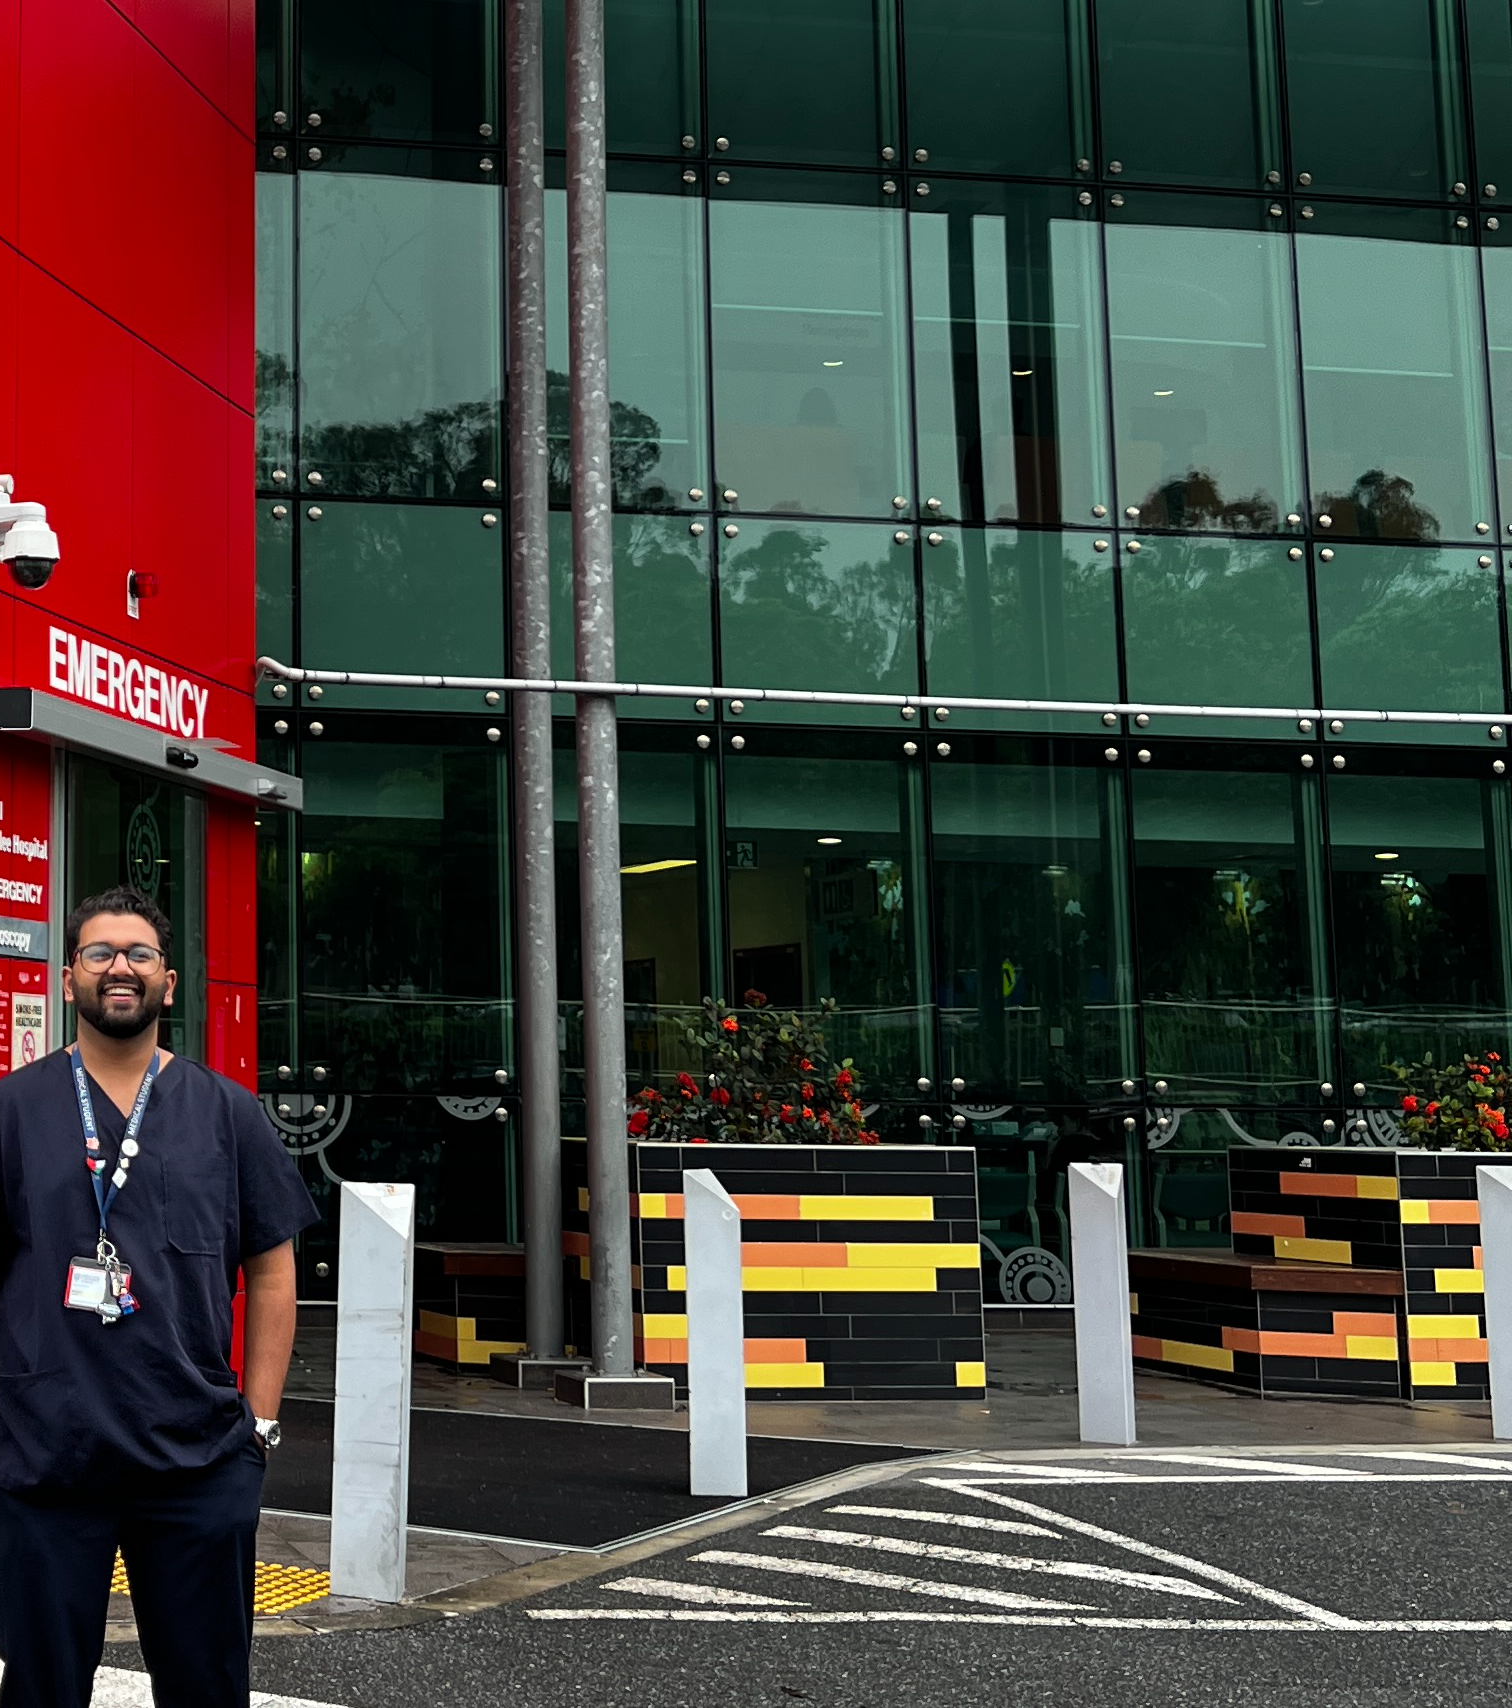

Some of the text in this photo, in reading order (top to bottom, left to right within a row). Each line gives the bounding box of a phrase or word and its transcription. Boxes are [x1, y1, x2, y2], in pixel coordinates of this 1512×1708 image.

[49, 625, 209, 739] EMERGENCY
[13, 833, 48, 862] Hospital
[75, 1066, 95, 1132] MEDICAL STUDENT
[127, 1072, 155, 1136] MEDICAL STUDENT
